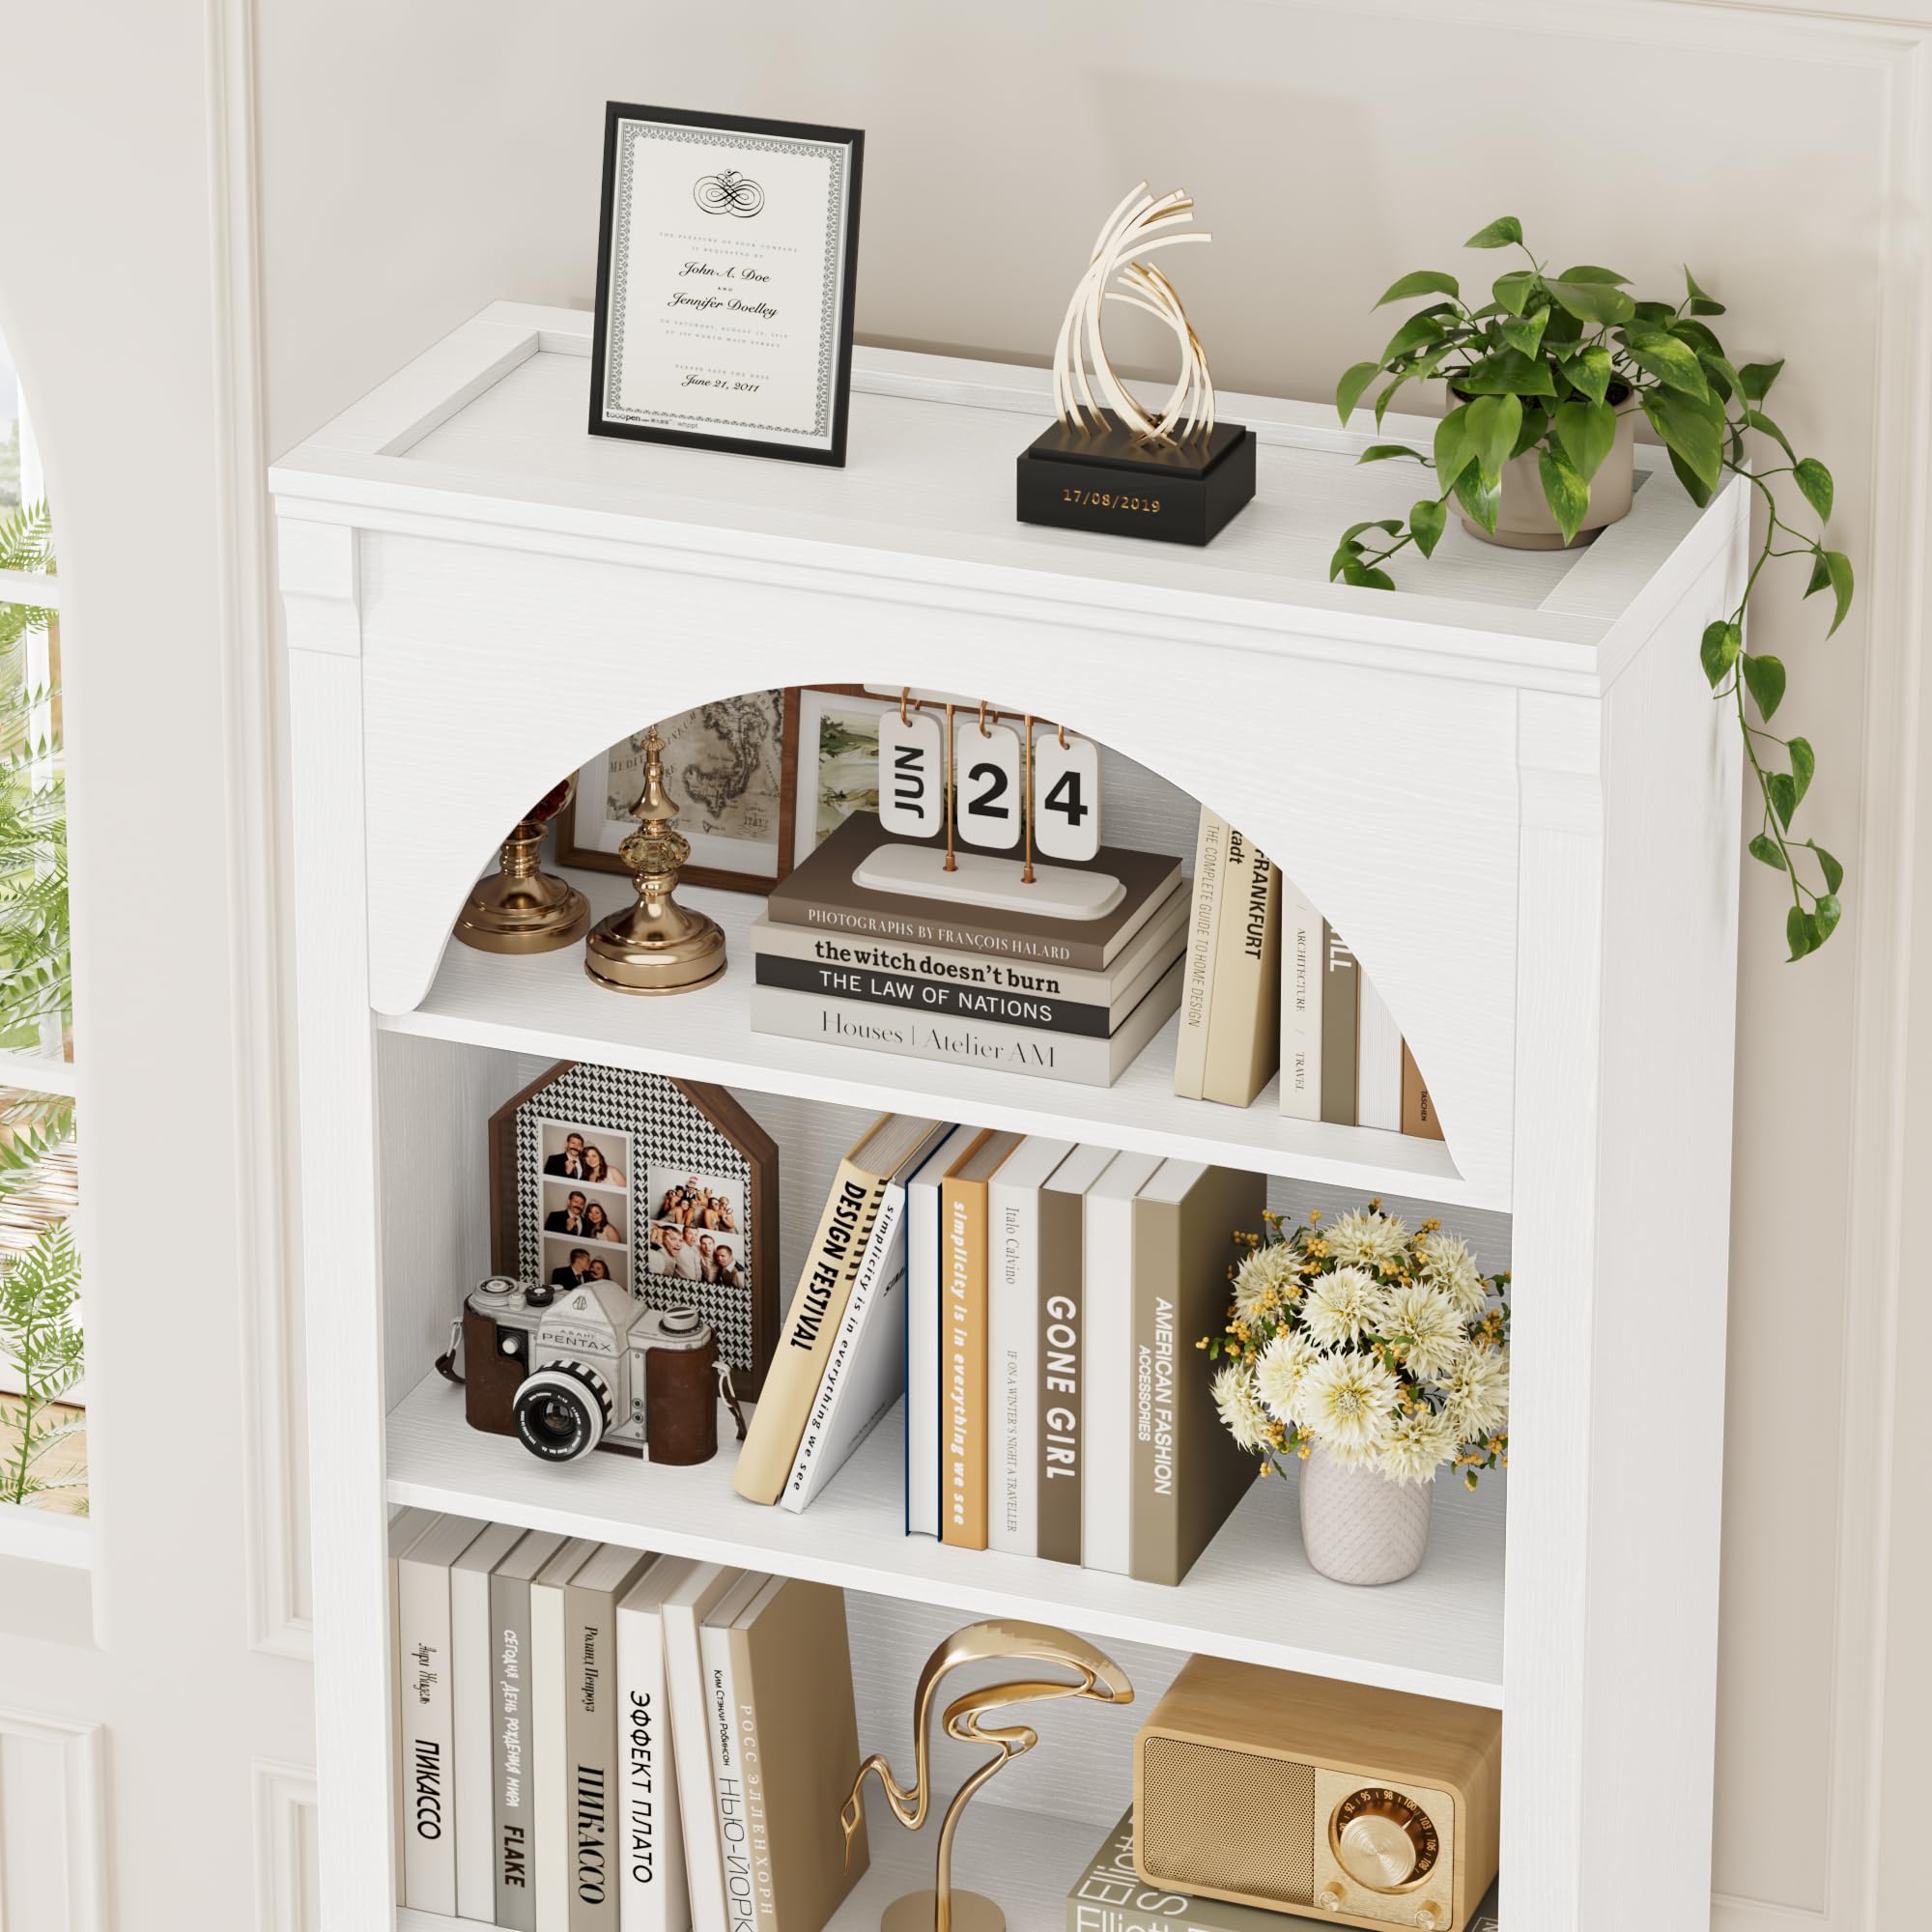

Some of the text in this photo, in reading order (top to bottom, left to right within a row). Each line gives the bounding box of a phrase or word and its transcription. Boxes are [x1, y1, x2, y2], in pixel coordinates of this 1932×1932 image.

[679, 261, 716, 277] John
[741, 268, 773, 283] Doe
[668, 292, 780, 320] Jennifer Doelley
[681, 374, 761, 393] June 21, 2011
[1063, 488, 1161, 513] 17/08/2019
[895, 745, 1089, 827] JUN 2 4
[809, 908, 1070, 960] PHOTOGRAPHS BY FRANÇOIS HALARD
[1188, 825, 1220, 1028] THE COMPLETE GUIDE TO HOME DESIGN
[815, 940, 851, 962] the
[854, 948, 917, 973] witch
[1007, 968, 1061, 994] burn
[1296, 927, 1306, 1012] ARCHITECTURE
[819, 970, 1052, 1022] THE LAW OF NATIONS
[823, 1010, 904, 1044] Houses
[924, 1029, 1005, 1060] Atelier
[1008, 1042, 1054, 1068] AM
[1294, 1051, 1305, 1093] TRAVEL
[790, 1180, 867, 1351] DESIGN FESTIVAL
[860, 1205, 895, 1291] simplicity
[1006, 1207, 1020, 1285] Italo Calvino
[846, 1317, 859, 1333] in
[854, 1296, 866, 1312] is
[542, 1333, 611, 1352] PENTAX
[559, 1329, 594, 1339] ASAHI
[1007, 1350, 1017, 1360] IF
[811, 1340, 848, 1431] everything
[951, 1201, 968, 1526] simplicity is in everything we see
[1007, 1361, 1017, 1377] ON
[1046, 1295, 1077, 1479] GONE GIRL
[1138, 1345, 1151, 1442] ACCESSORIES
[1154, 1296, 1174, 1495] AMERICAN FASHION
[805, 1435, 816, 1458] we
[1007, 1435, 1017, 1468] NIGHT
[793, 1463, 807, 1491] see
[1007, 1476, 1017, 1532] TRAVELLER
[581, 1626, 599, 1713] Роланд Пенроуз
[499, 1629, 522, 1807] СЕГОДНЯ ДЕНЬ РОЖДЕНИЯ МИРА
[714, 1669, 730, 1767] Ким Стэнли Робинсон
[415, 1739, 441, 1840] ПИКАССО
[630, 1690, 653, 1884] ЭФФЕКТ ПЛАТО
[740, 1704, 773, 1915] РОСС ЭЛЛЕНХОРН
[1344, 1803, 1355, 1813] 92
[1360, 1791, 1371, 1802] 95
[1383, 1790, 1394, 1801] 98
[1403, 1798, 1417, 1811] 100
[578, 1763, 606, 1906] ПИКАССО
[1419, 1816, 1432, 1830] 103
[1426, 1838, 1436, 1852] 106
[503, 1824, 526, 1889] FLAKE
[719, 1777, 753, 1932] НЬЮ-ЙОРК
[1418, 1857, 1432, 1871] 108
